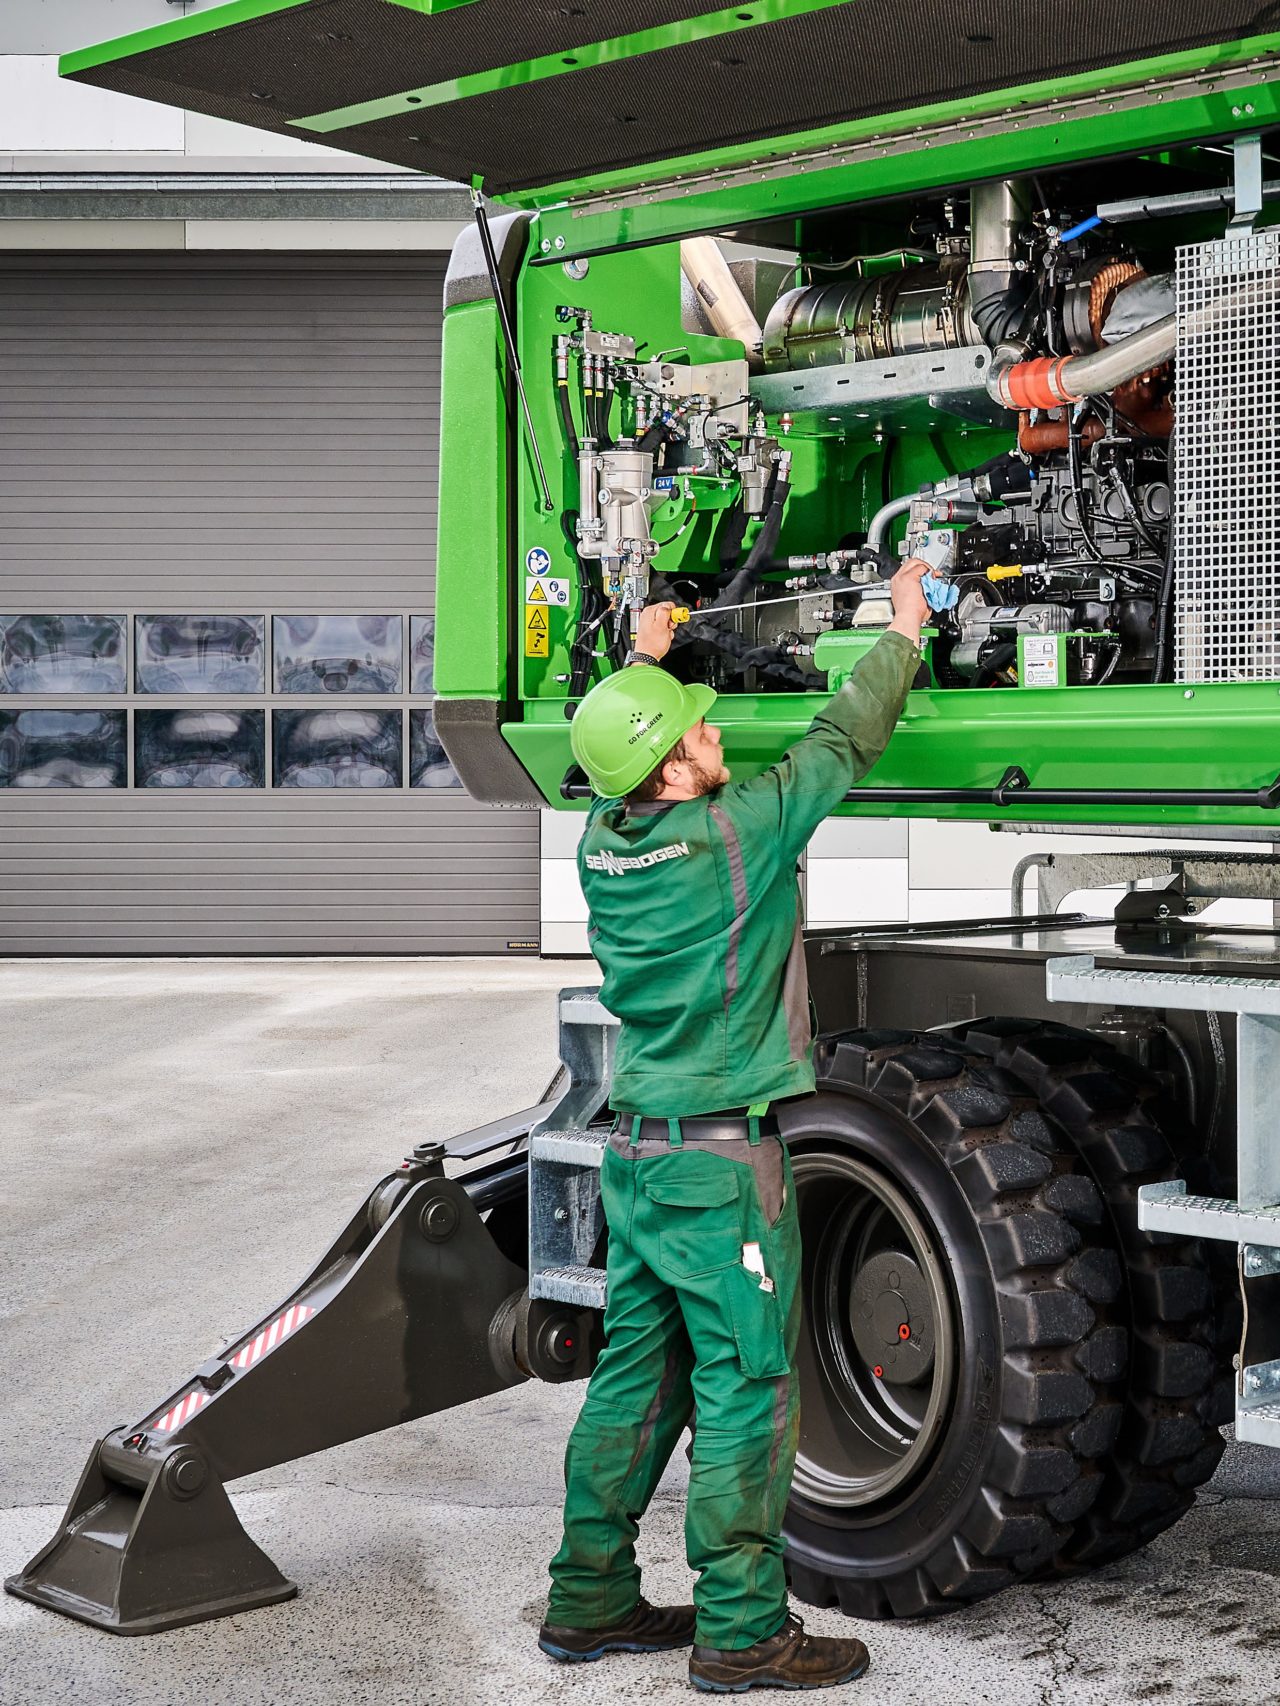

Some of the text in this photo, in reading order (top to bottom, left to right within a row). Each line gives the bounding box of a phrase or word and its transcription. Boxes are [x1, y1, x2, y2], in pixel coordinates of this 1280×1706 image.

[657, 479, 671, 488] 24 V
[628, 711, 664, 745] GO FOR GREEN
[585, 842, 690, 876] SENNEBOGEN
